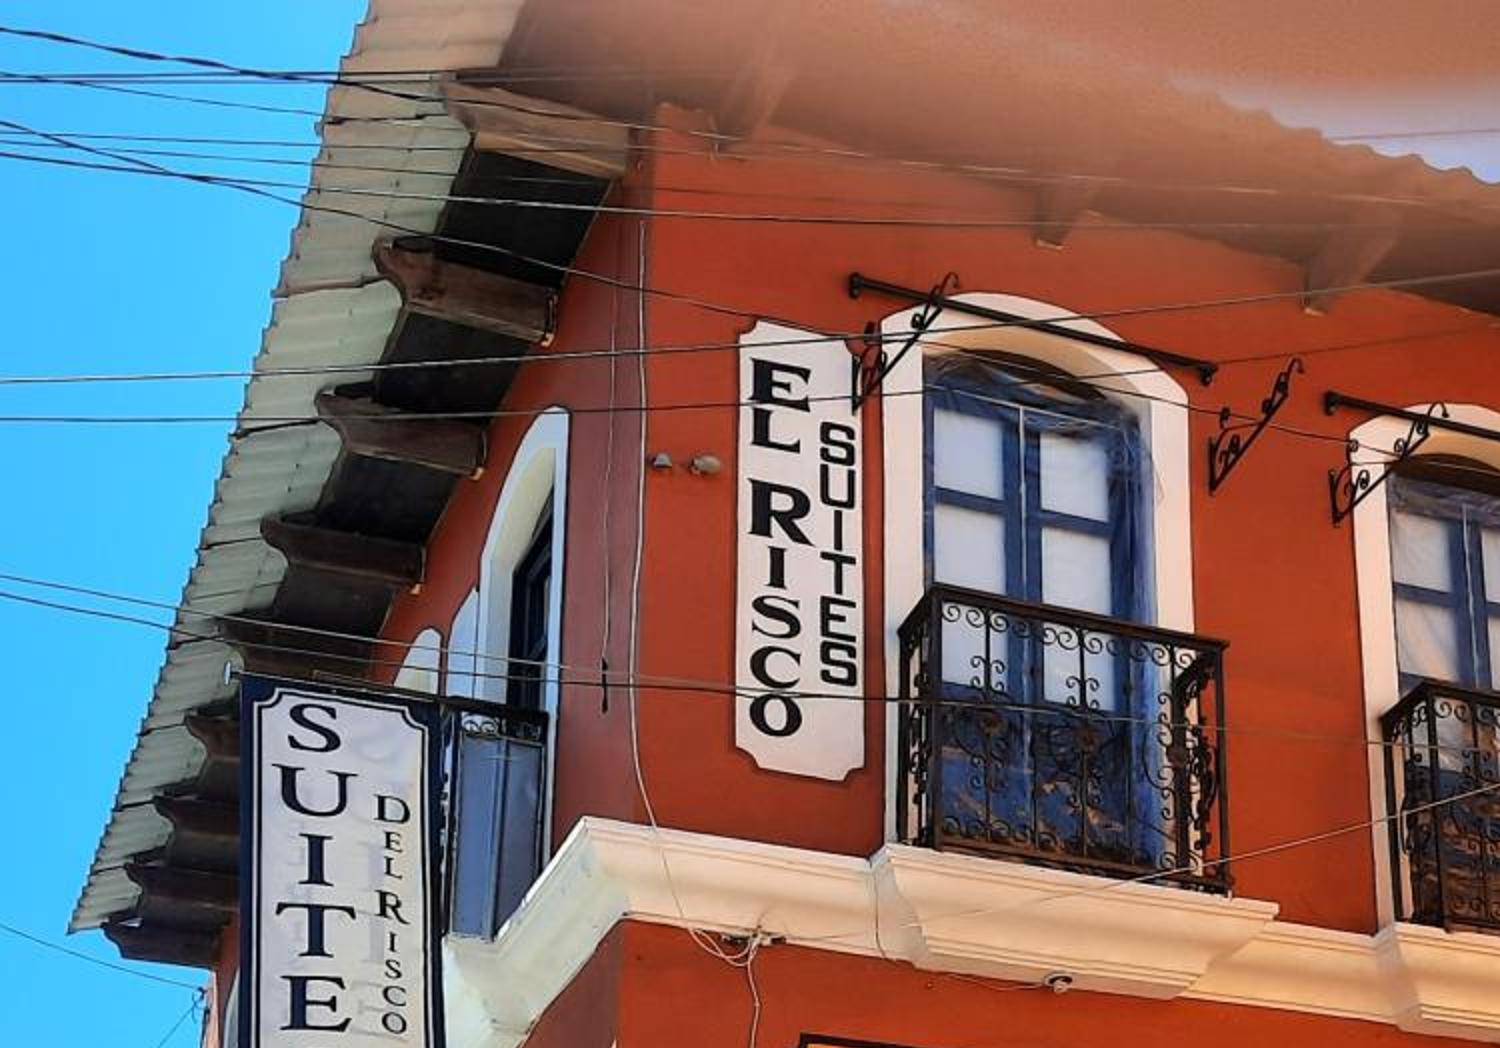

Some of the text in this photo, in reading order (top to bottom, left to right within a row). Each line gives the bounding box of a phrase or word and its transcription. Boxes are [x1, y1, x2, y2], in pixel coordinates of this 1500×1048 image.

[747, 357, 815, 737] EL RISCO
[819, 421, 858, 688] SUITES
[373, 793, 411, 1036] DEL RISCO
